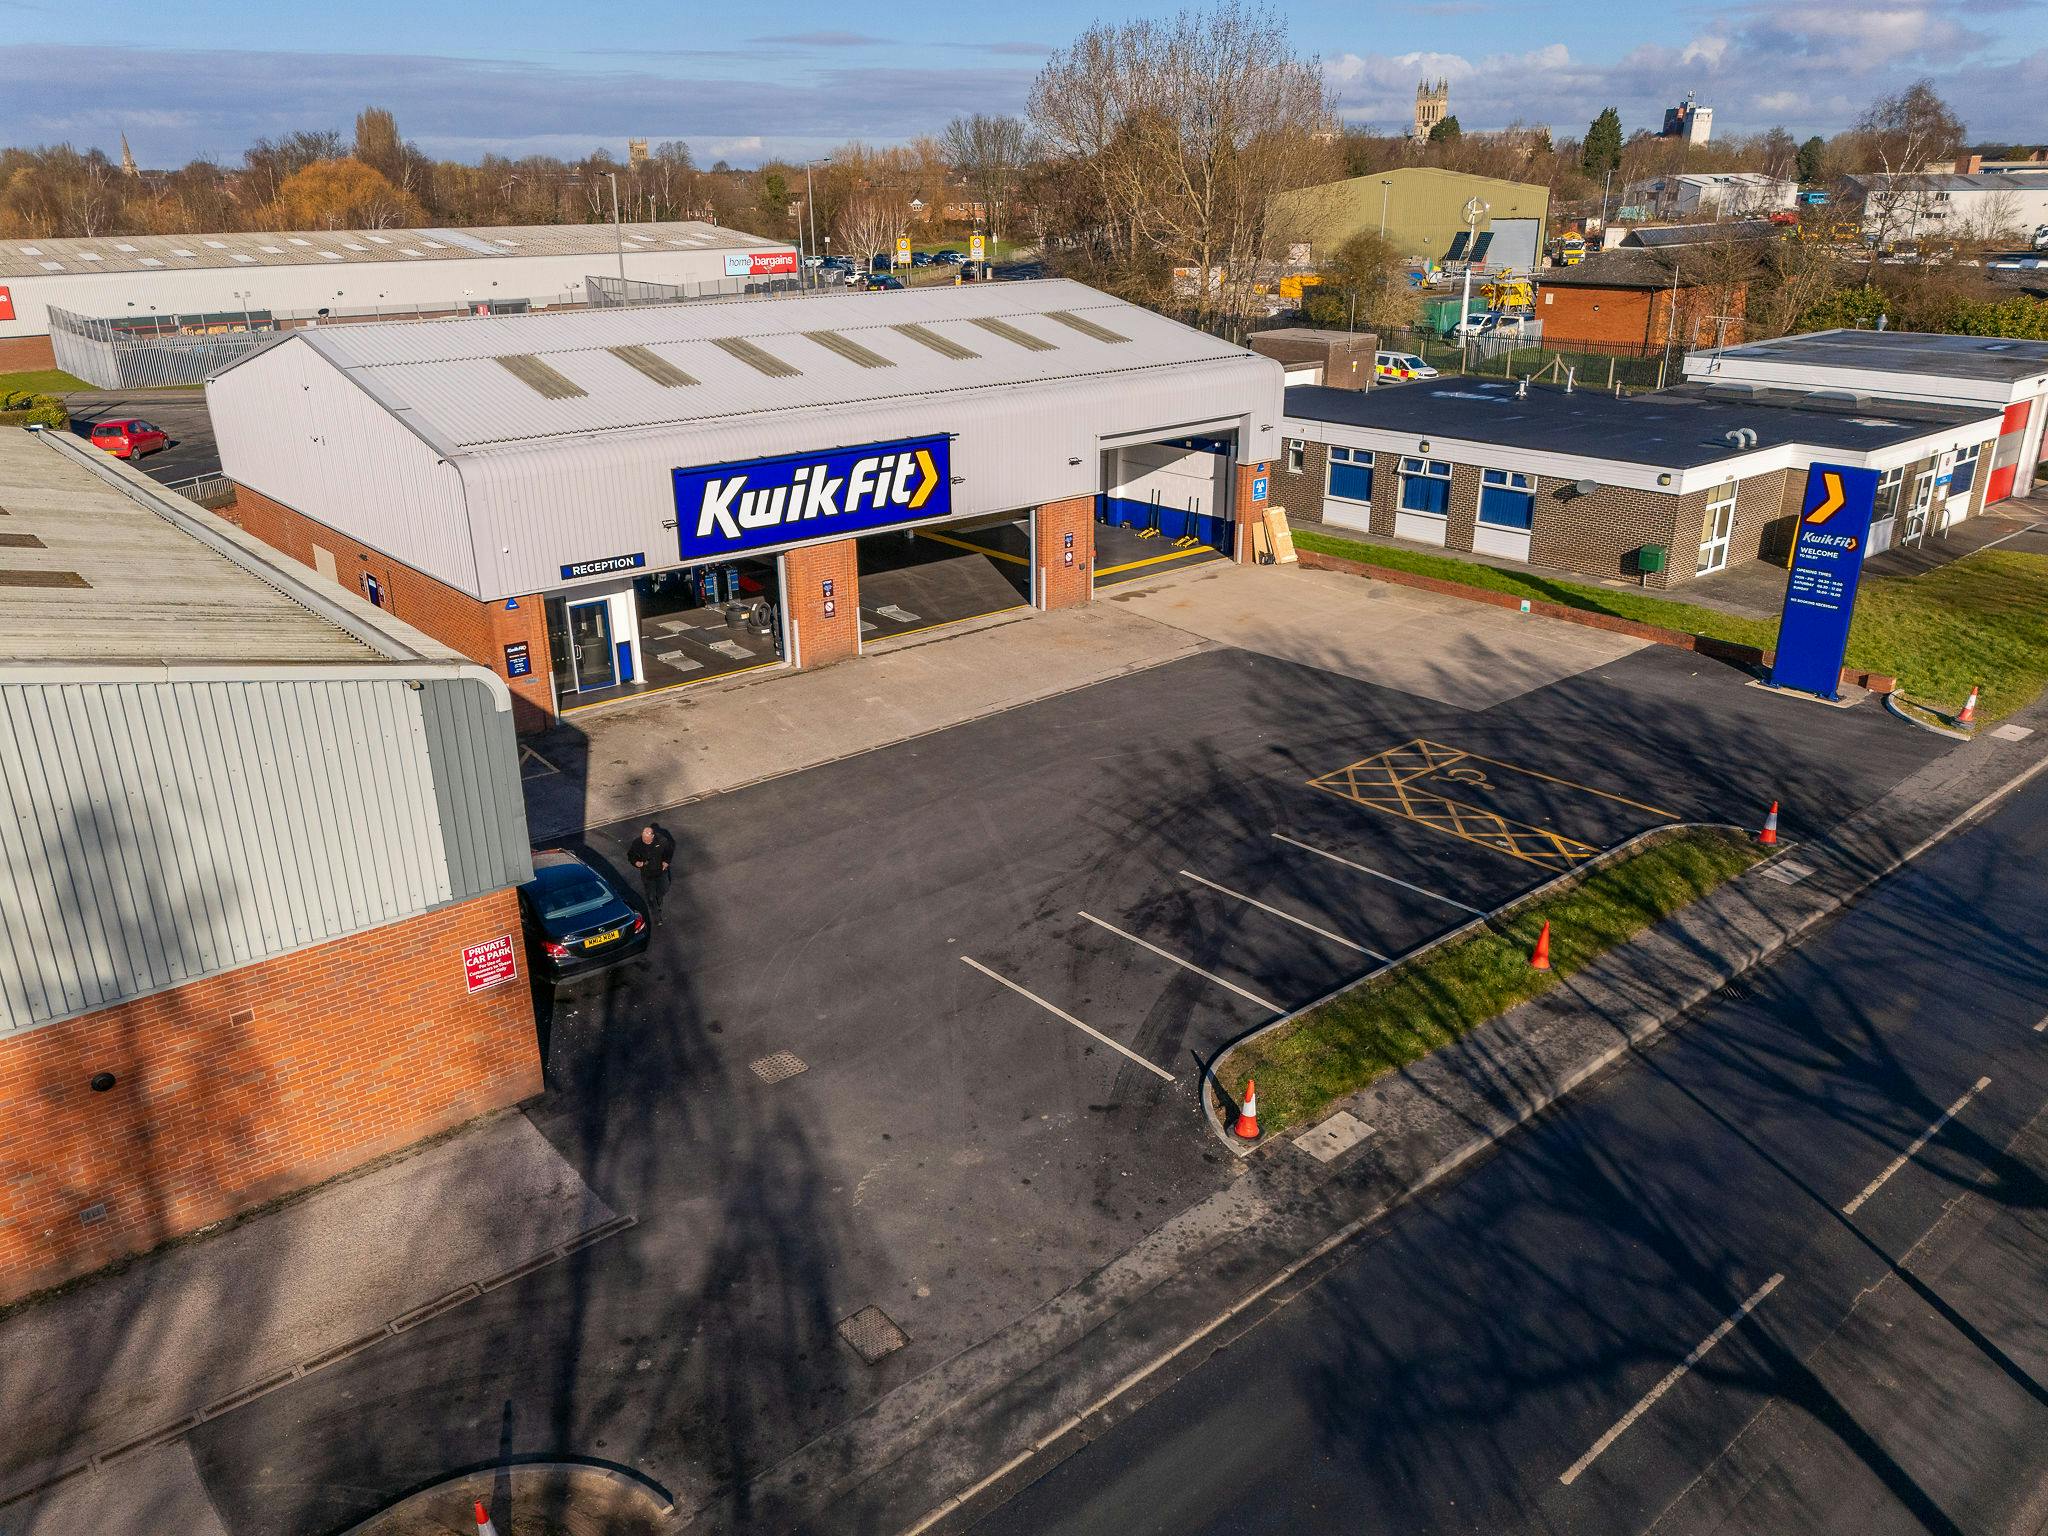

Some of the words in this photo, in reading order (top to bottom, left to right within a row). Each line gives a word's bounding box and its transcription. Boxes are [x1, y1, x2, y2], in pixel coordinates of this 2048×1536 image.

[729, 256, 752, 267] home
[755, 254, 793, 268] bargains
[696, 464, 844, 540] Kwik
[844, 451, 917, 514] Fit
[1802, 531, 1834, 546] Kwik
[1833, 536, 1852, 548] Fit
[1800, 547, 1839, 559] WELCOME
[572, 556, 635, 576] RECEPTION
[1796, 567, 1818, 576] OPENING
[466, 955, 486, 968] CAR
[487, 946, 512, 962] PARK
[469, 938, 507, 958] PRIVATE
